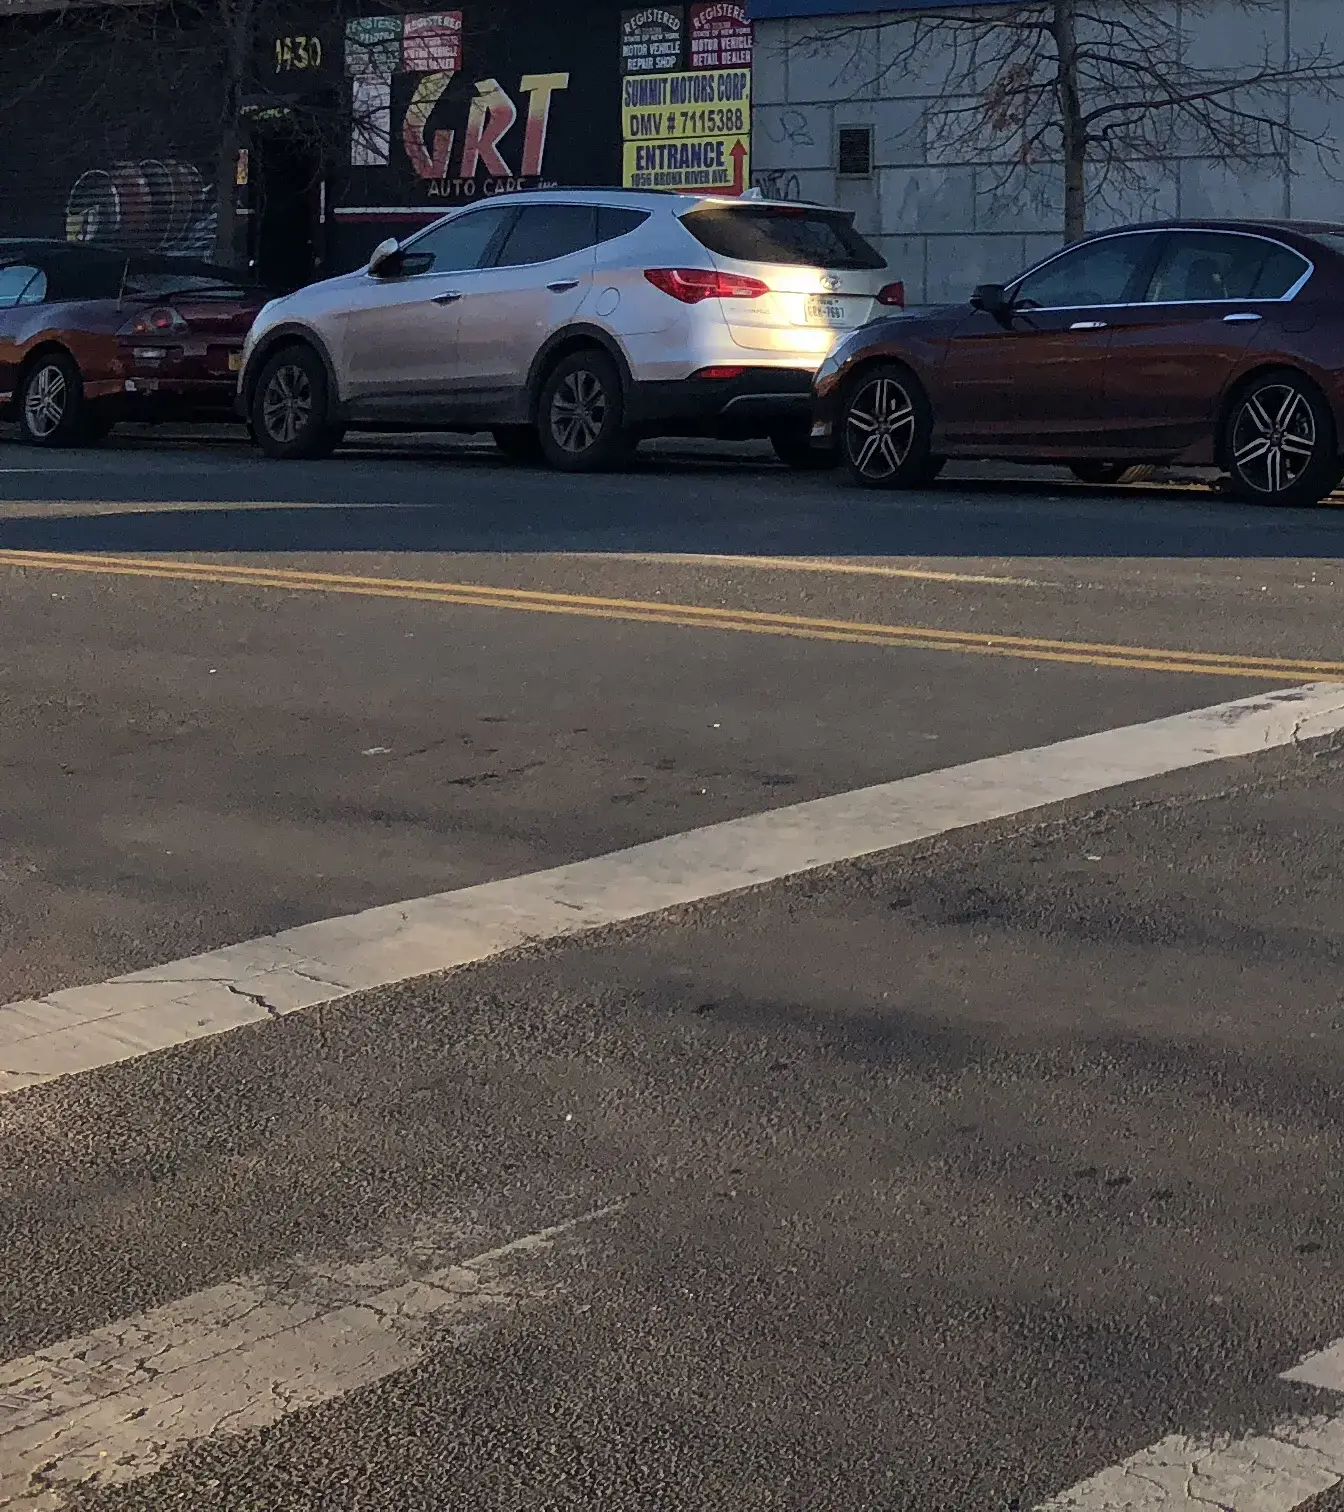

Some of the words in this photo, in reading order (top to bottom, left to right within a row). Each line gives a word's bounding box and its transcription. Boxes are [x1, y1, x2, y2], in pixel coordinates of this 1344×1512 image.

[624, 9, 681, 35] REGISTERED
[622, 44, 648, 57] MOTOR
[649, 41, 680, 55] VEHICLE
[692, 38, 718, 52] MOTOR
[721, 36, 753, 50] VEHICLE
[628, 57, 654, 71] REPAIR
[656, 56, 676, 68] SHOP
[693, 53, 719, 67] RETAIL
[721, 50, 751, 65] DEALER
[625, 78, 669, 108] SUMMIT
[670, 74, 715, 105] MOTORS
[717, 72, 749, 103] CORP.
[403, 70, 570, 179] GRT
[630, 113, 663, 137] DMV
[666, 112, 676, 135] #
[680, 108, 744, 134] 7115388
[635, 141, 726, 171] ENTRANCE
[427, 178, 476, 198] AUTO
[653, 172, 683, 186] BRONX
[684, 170, 710, 185] RIVER
